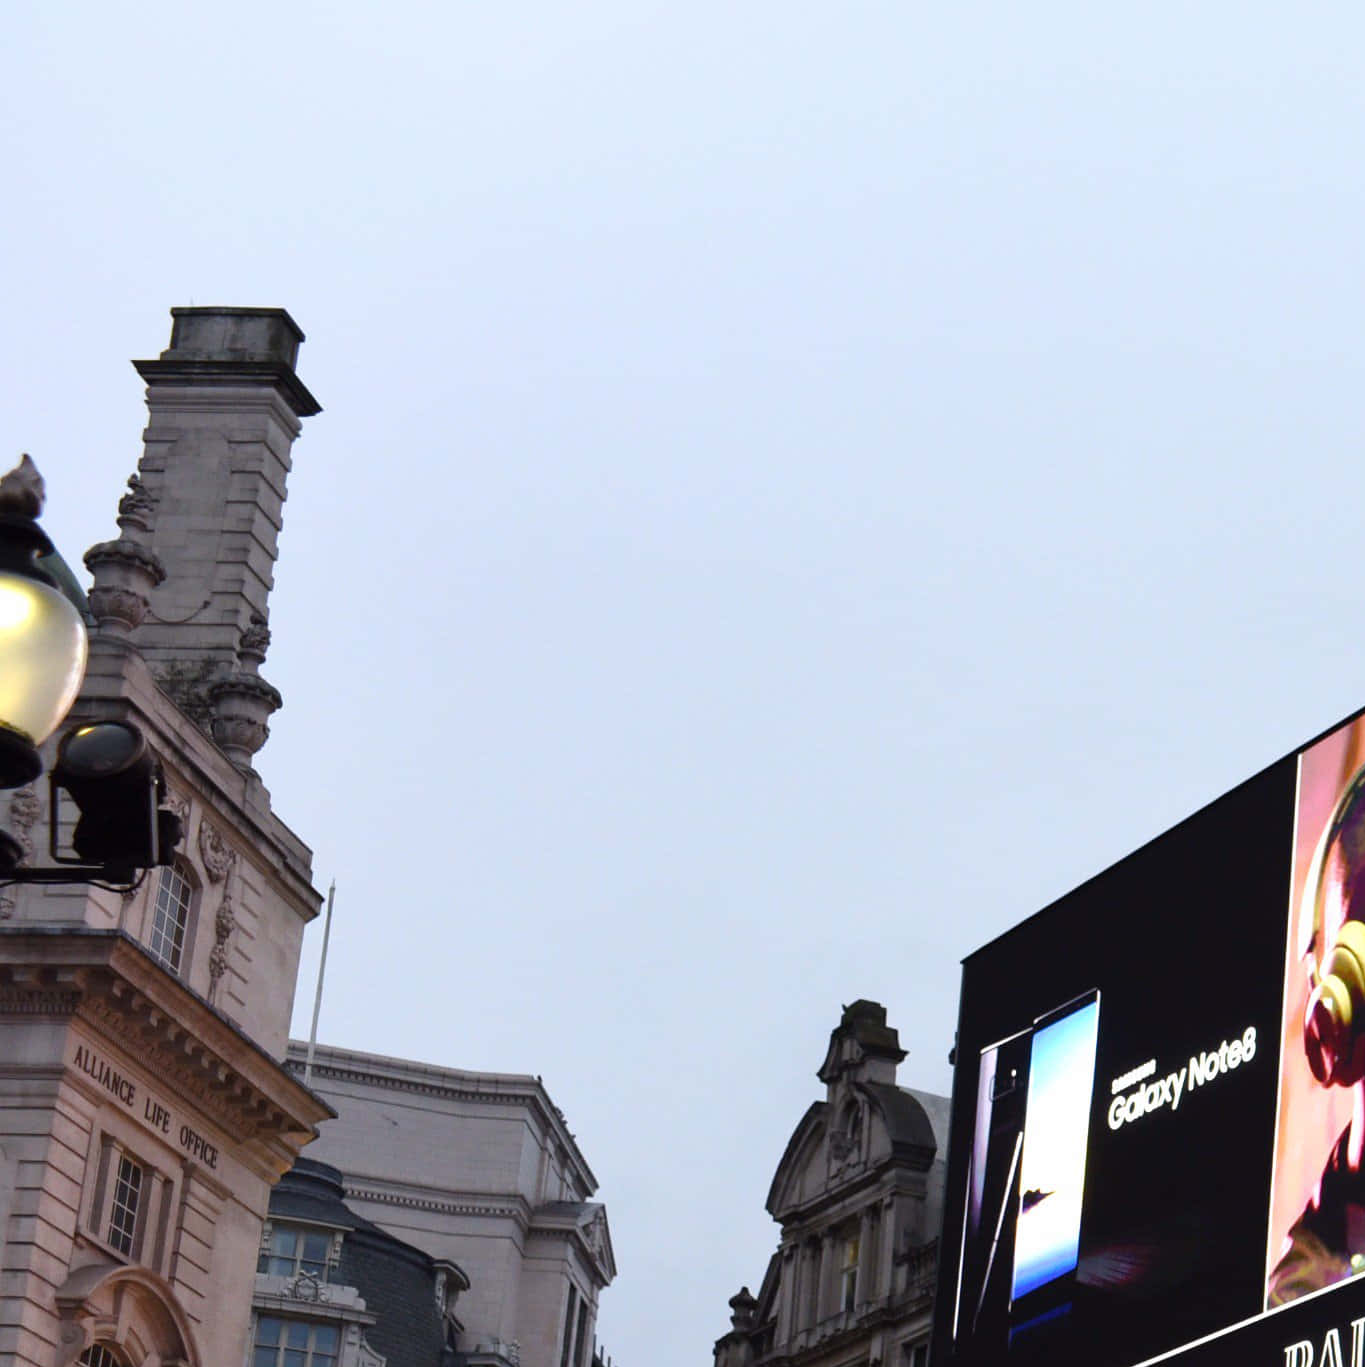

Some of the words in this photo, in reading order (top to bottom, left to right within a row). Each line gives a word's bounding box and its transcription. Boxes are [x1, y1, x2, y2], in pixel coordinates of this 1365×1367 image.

[73, 1045, 136, 1107] ALLIANCE
[143, 1097, 171, 1134] LIFE
[179, 1125, 219, 1170] OFFICE
[1107, 1067, 1187, 1130] Galaxy
[1188, 1026, 1257, 1091] Note8
